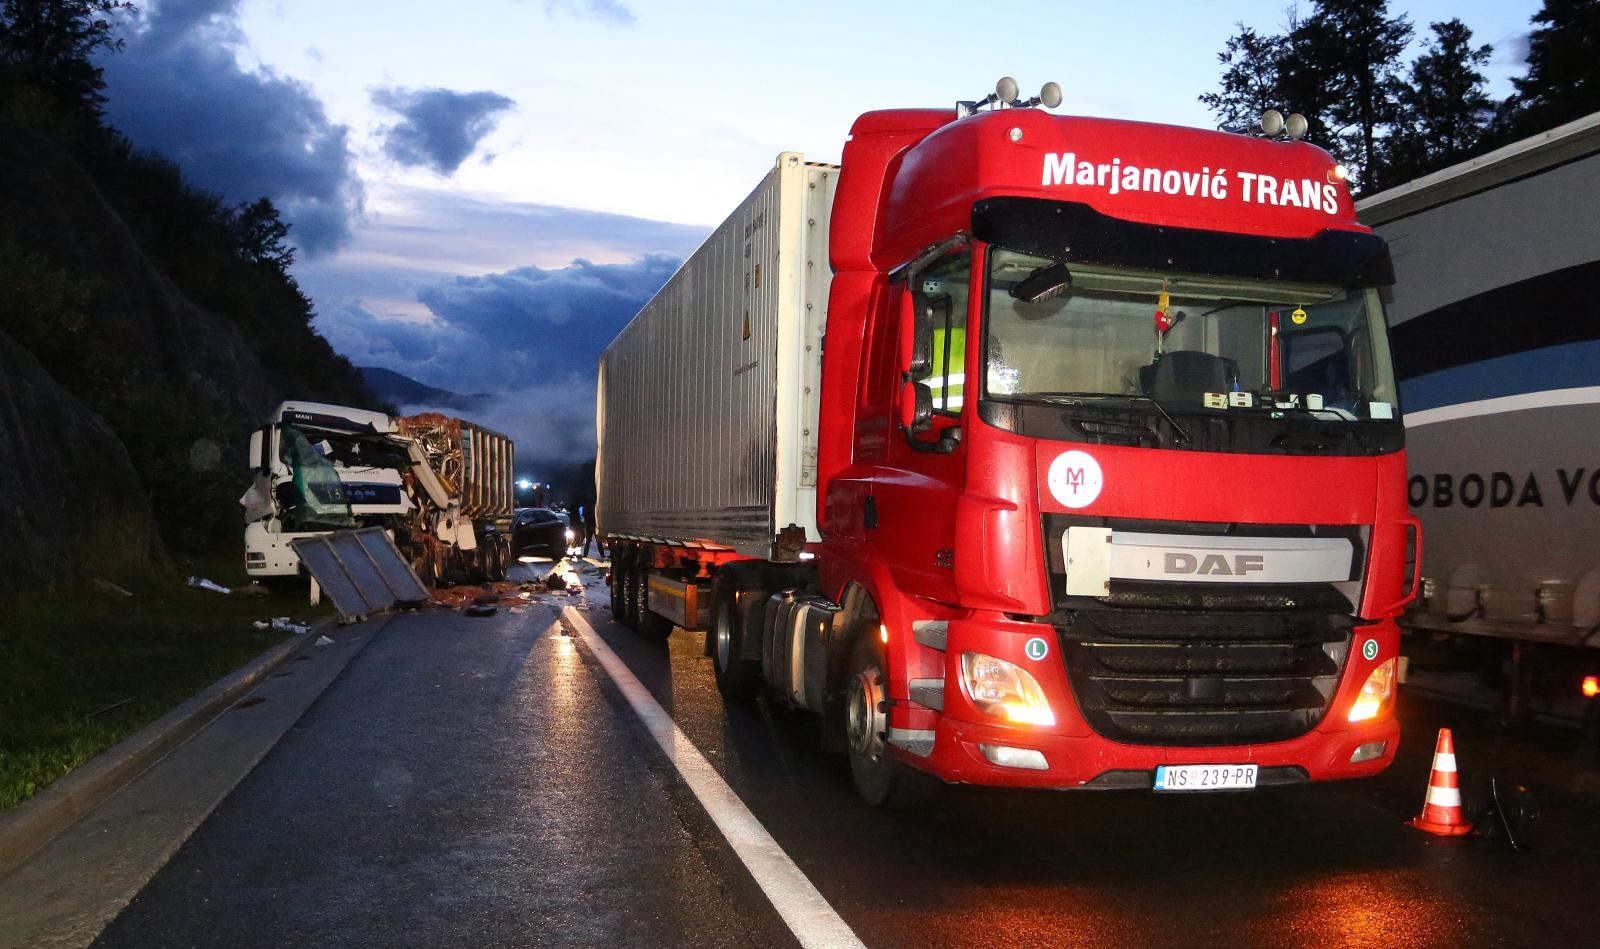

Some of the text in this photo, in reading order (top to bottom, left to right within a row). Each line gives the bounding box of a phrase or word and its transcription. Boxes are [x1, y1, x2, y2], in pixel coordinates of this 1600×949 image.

[1041, 152, 1338, 215] Marjanović TRANS
[1164, 552, 1264, 576] DAF
[1032, 642, 1041, 656] L
[1367, 643, 1374, 656] S
